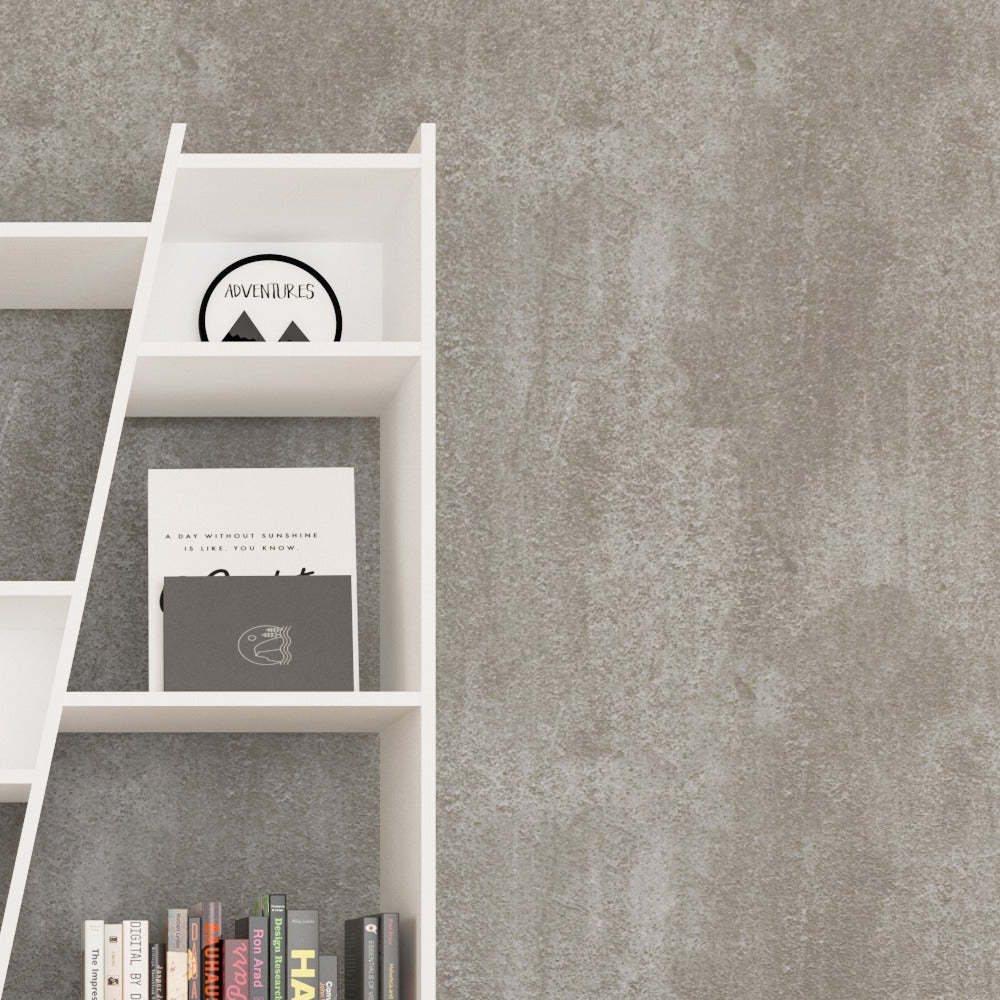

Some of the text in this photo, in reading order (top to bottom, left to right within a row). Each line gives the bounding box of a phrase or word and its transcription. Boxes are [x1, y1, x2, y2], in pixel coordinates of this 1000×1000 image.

[224, 283, 315, 299] ADVENTURES
[130, 921, 142, 966] DIGITAL
[253, 929, 264, 954] Ron
[273, 918, 283, 952] Design
[91, 949, 100, 966] The
[130, 973, 142, 986] BY
[253, 958, 264, 988] Arad
